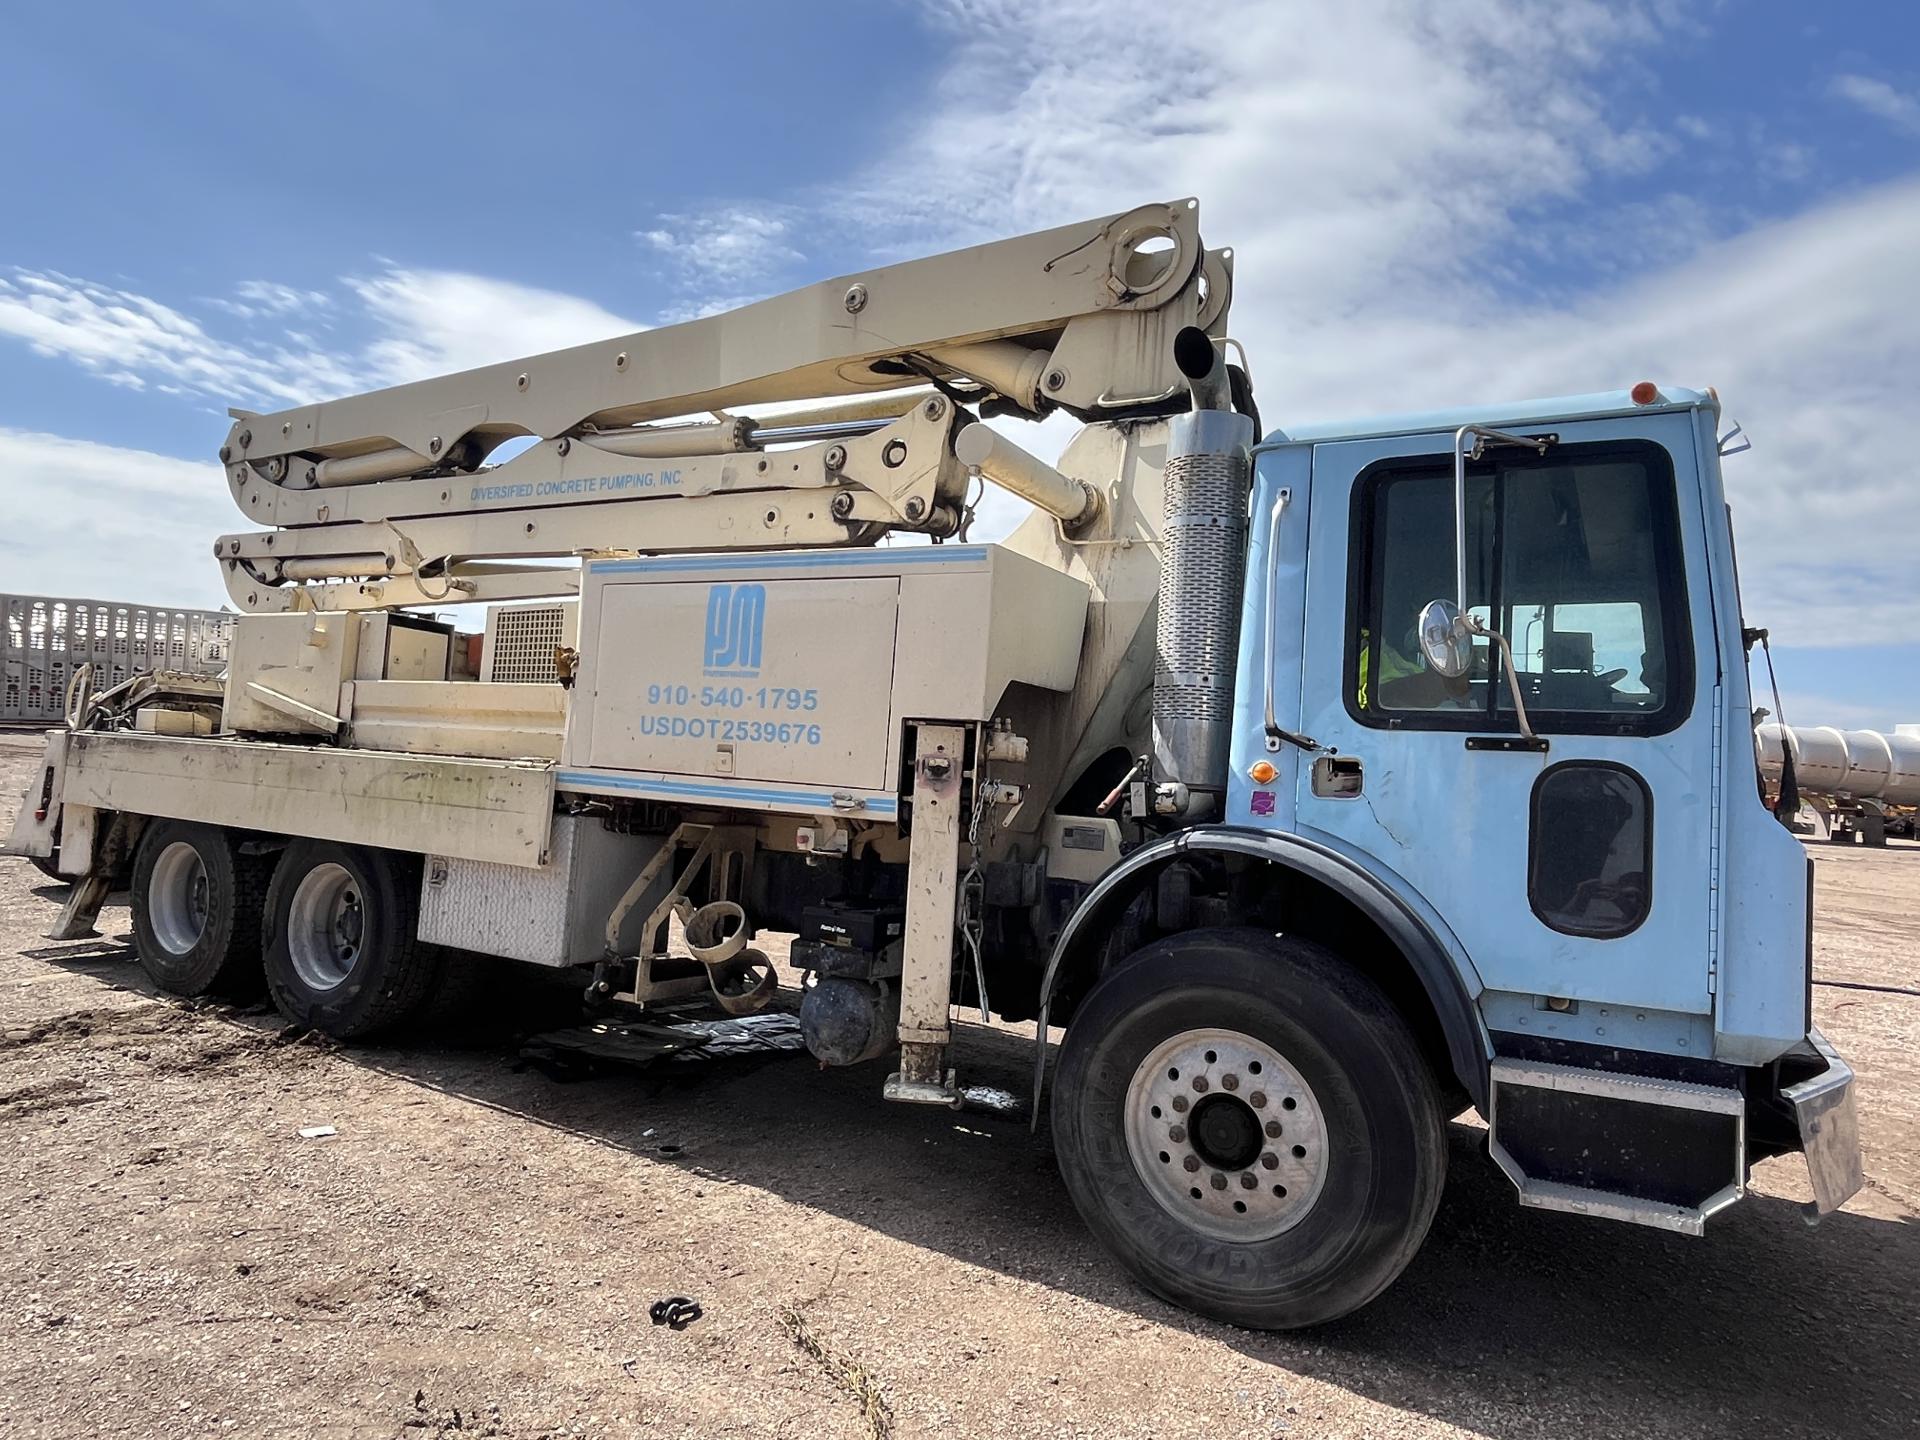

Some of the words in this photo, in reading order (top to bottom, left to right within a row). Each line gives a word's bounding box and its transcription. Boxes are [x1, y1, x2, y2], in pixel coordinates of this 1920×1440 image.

[470, 482, 533, 500] DIVERSIFIED
[536, 477, 597, 496] CONCRETE
[599, 472, 656, 490] PUMPING,
[659, 469, 684, 486] INC.
[640, 715, 822, 745] USDOT2539676
